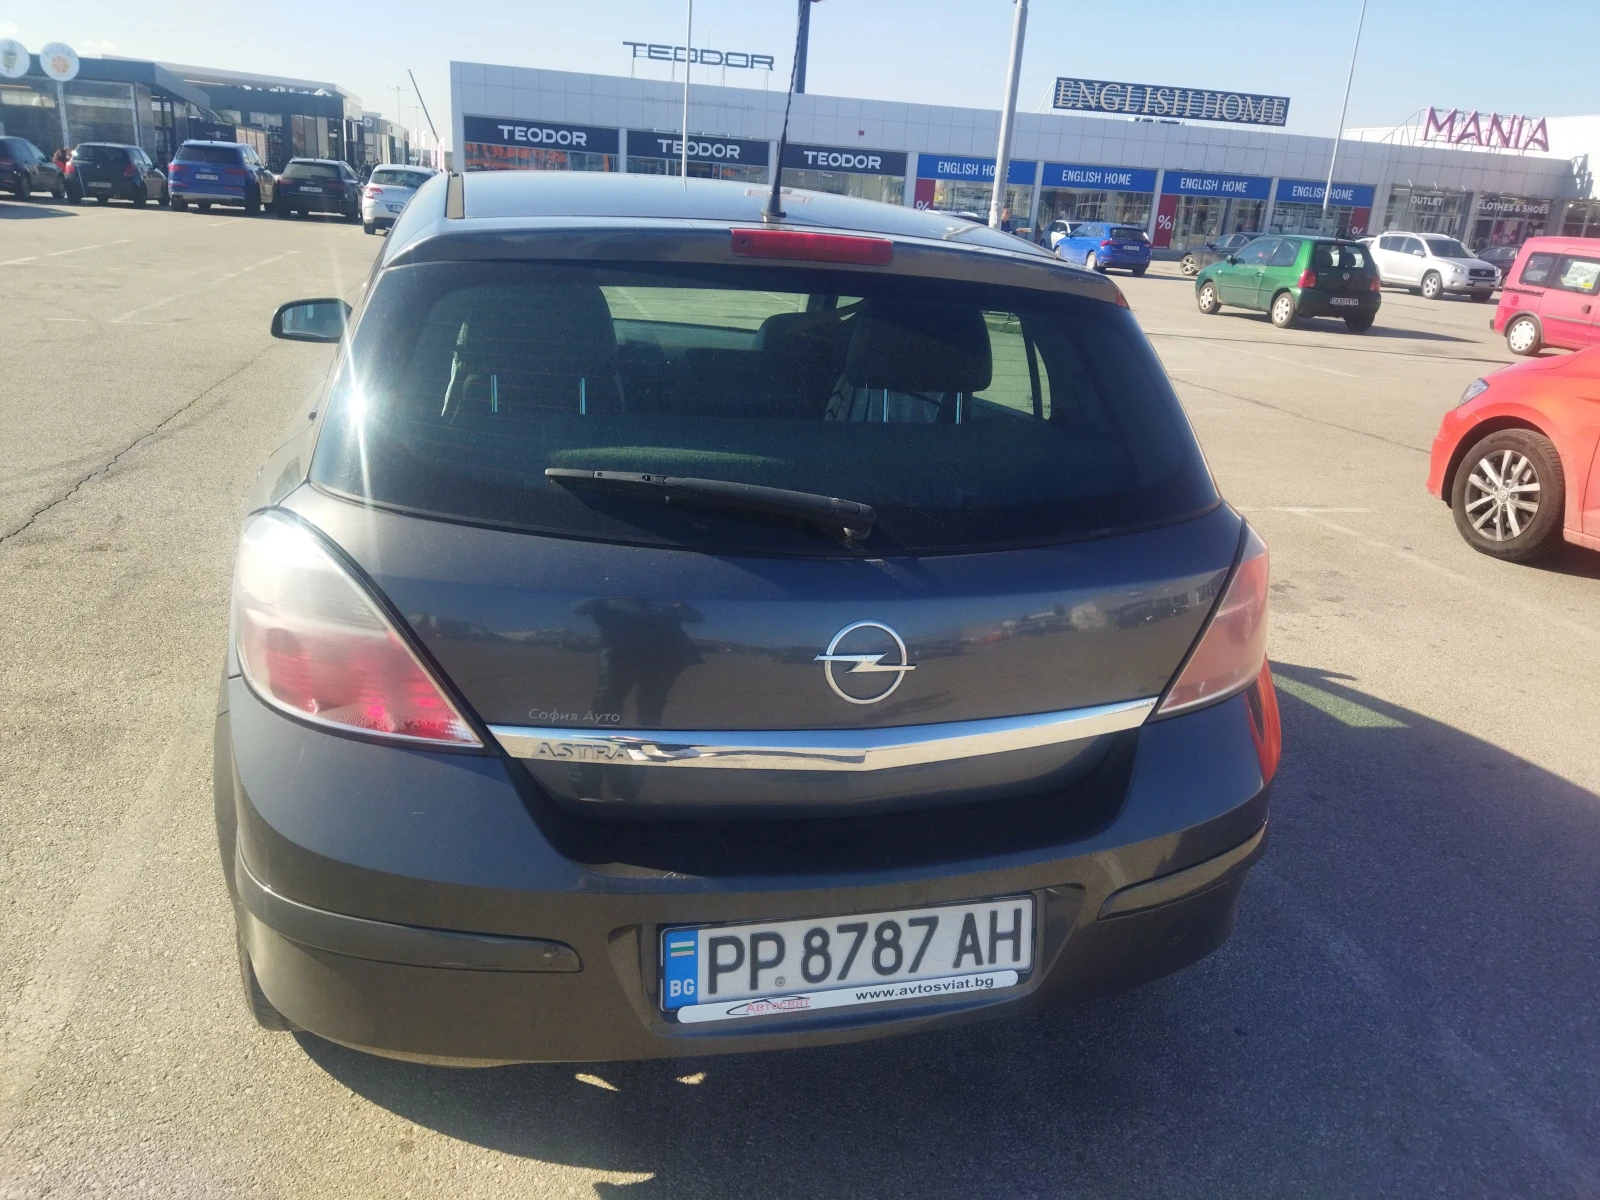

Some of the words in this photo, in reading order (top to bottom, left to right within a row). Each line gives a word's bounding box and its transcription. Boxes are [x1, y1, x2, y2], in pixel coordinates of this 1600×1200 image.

[622, 40, 775, 71] TEODOR
[1056, 79, 1194, 117] ENGLISH
[1199, 91, 1286, 124] HOME
[497, 124, 587, 147] TEODOR
[1422, 105, 1550, 152] MANIA
[656, 138, 741, 159] TEODOR
[803, 150, 882, 170] TEODOR
[937, 161, 979, 176] ENGLISH
[1061, 169, 1102, 184] ENGLISH
[1104, 172, 1132, 185] HOME
[1180, 177, 1219, 191] ENGLISH
[1221, 180, 1248, 193] HOME
[1291, 185, 1327, 199] ENGLISH
[1329, 188, 1354, 201] HOME
[1410, 195, 1444, 206] OUTLET
[1477, 201, 1514, 212] CLOTHES
[1522, 204, 1550, 214] SHOES
[1158, 214, 1172, 230] %
[528, 708, 578, 723] София
[583, 710, 620, 724] Ауто
[532, 741, 633, 762] ASTRA
[707, 931, 786, 995] PP
[800, 915, 939, 984] 8787
[952, 907, 1023, 969] AH
[669, 978, 695, 998] BG
[854, 974, 995, 1001] www.avtosviat.bg
